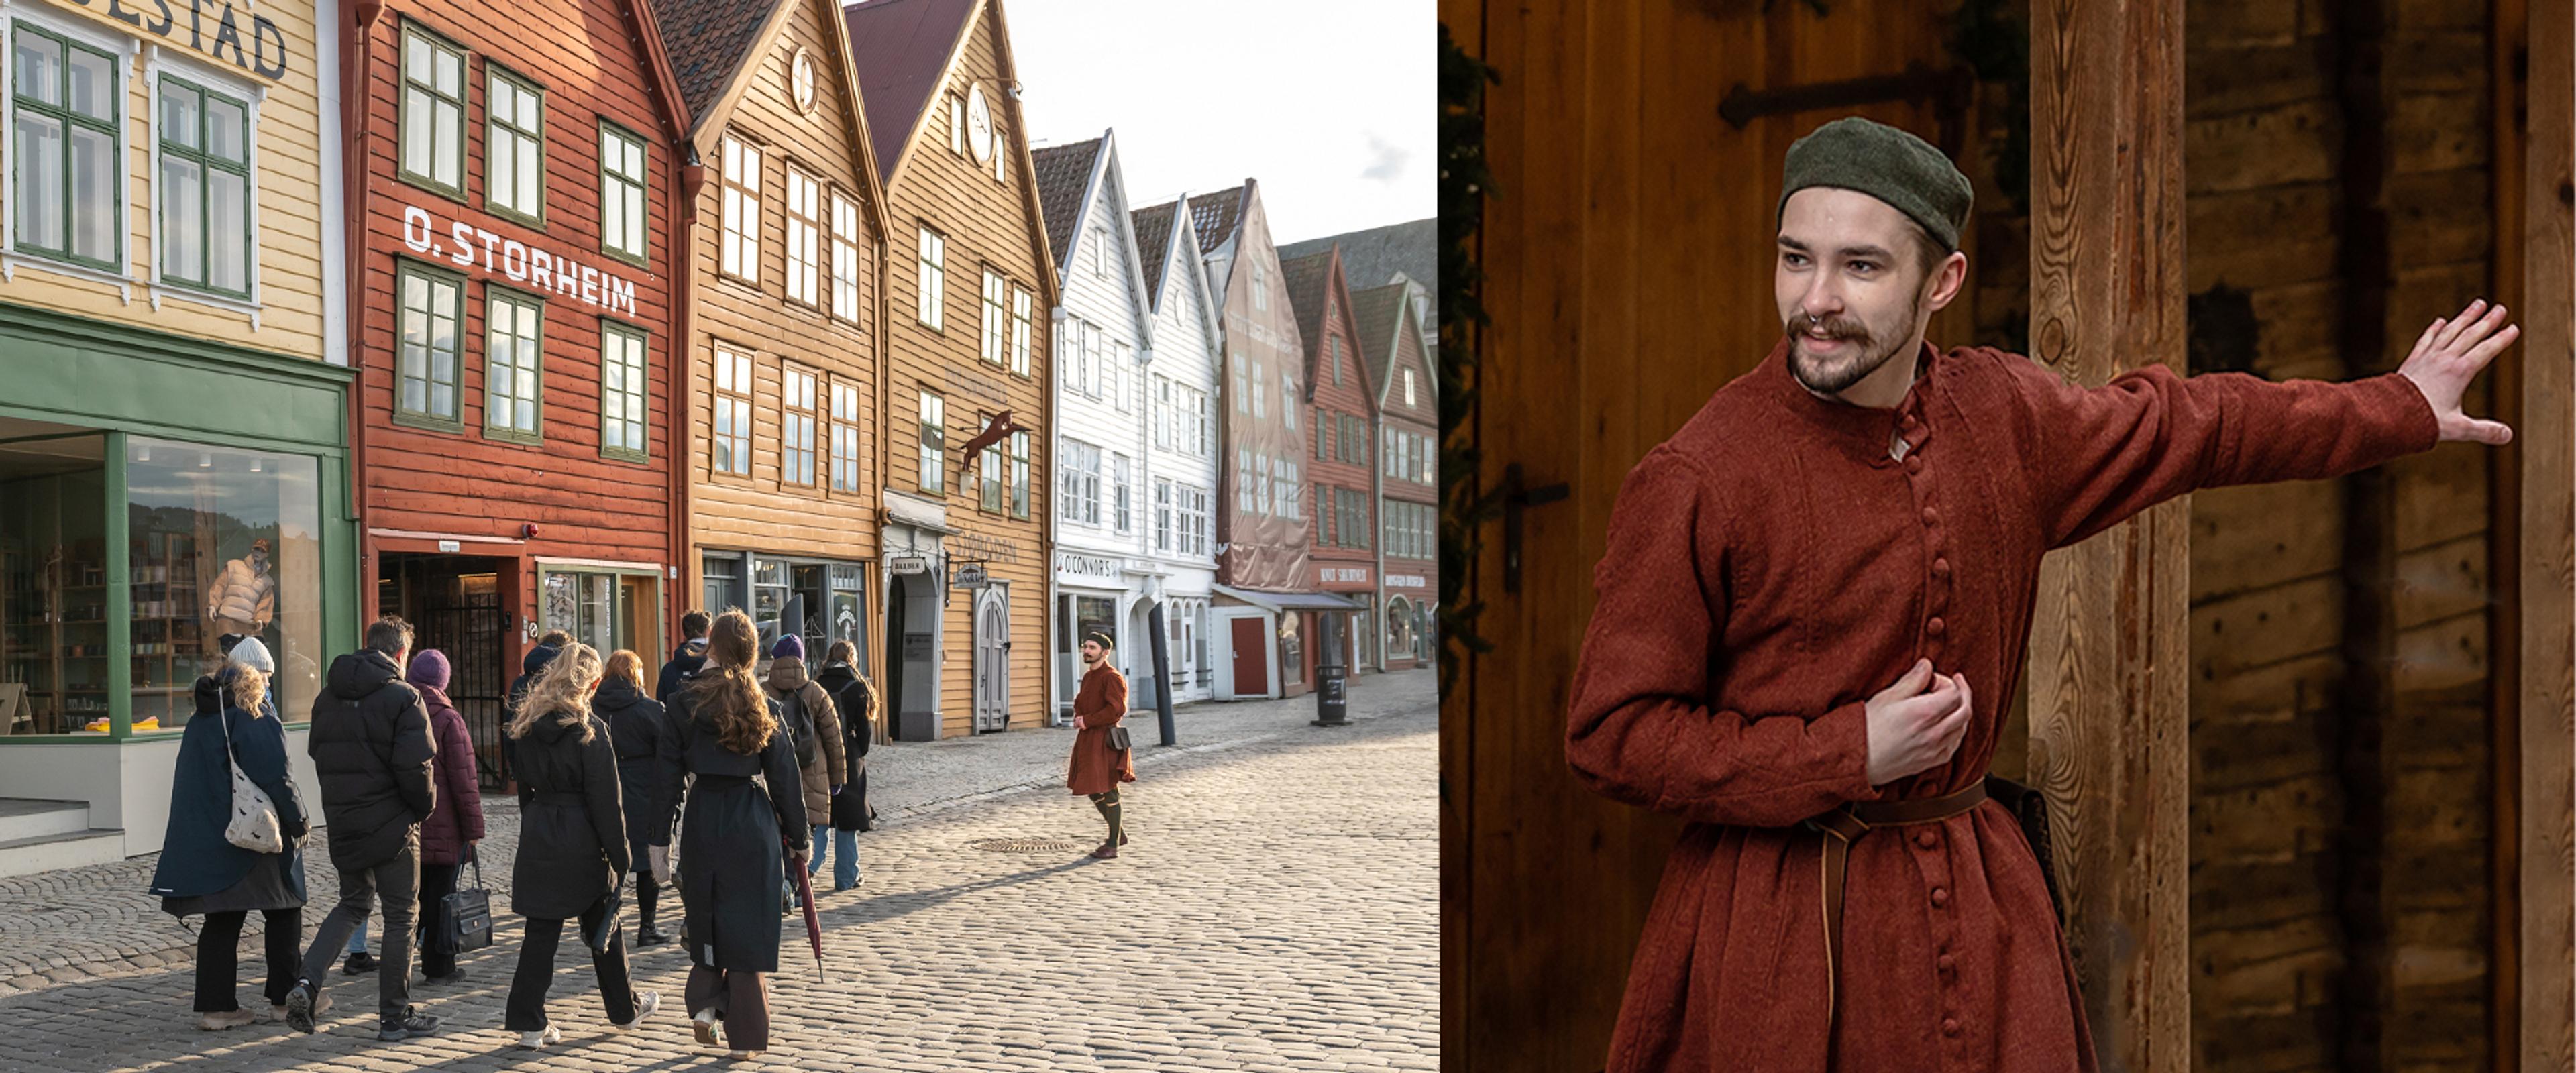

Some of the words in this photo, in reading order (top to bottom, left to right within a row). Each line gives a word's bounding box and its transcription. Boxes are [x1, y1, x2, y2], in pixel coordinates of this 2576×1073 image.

[72, 0, 286, 80] STAD
[404, 205, 441, 258] O.
[451, 221, 636, 317] STORHEIM
